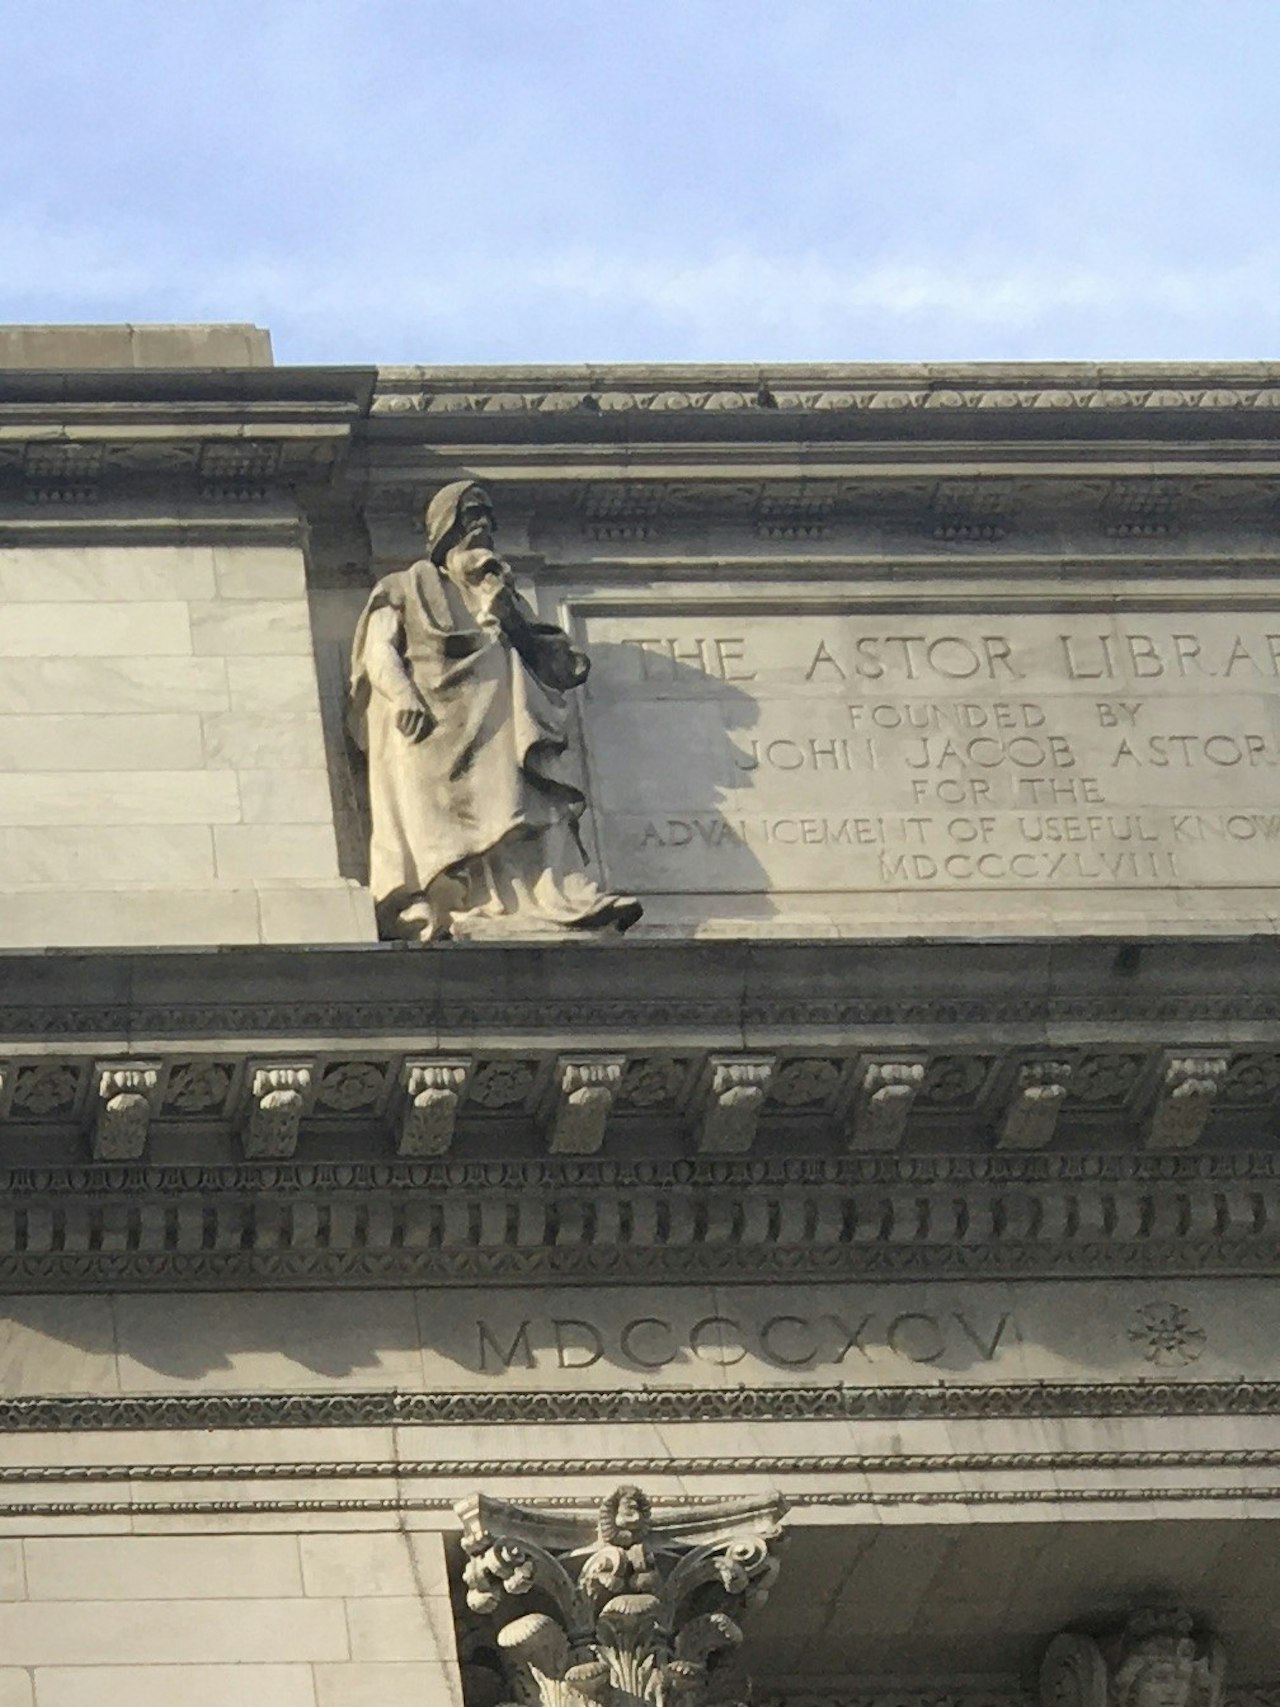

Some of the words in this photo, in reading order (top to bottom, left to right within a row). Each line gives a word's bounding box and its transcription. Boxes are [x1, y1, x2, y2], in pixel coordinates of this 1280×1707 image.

[620, 638, 758, 682] THE
[804, 635, 1028, 681] ASTOR
[848, 702, 1047, 730] FOUNDED
[1095, 702, 1144, 728] BY
[735, 737, 880, 772] JOHN
[904, 735, 1076, 769] JACOB
[1111, 734, 1276, 768] ASTOR
[912, 777, 993, 805] FOR
[1020, 778, 1105, 804] THE
[641, 817, 932, 846] ADVANCEMENT
[948, 815, 1000, 844] OF
[1017, 815, 1159, 844] USEFUL
[879, 852, 1178, 883] MDCCCXLVIII
[475, 1310, 1011, 1372] MDCCCXCV
